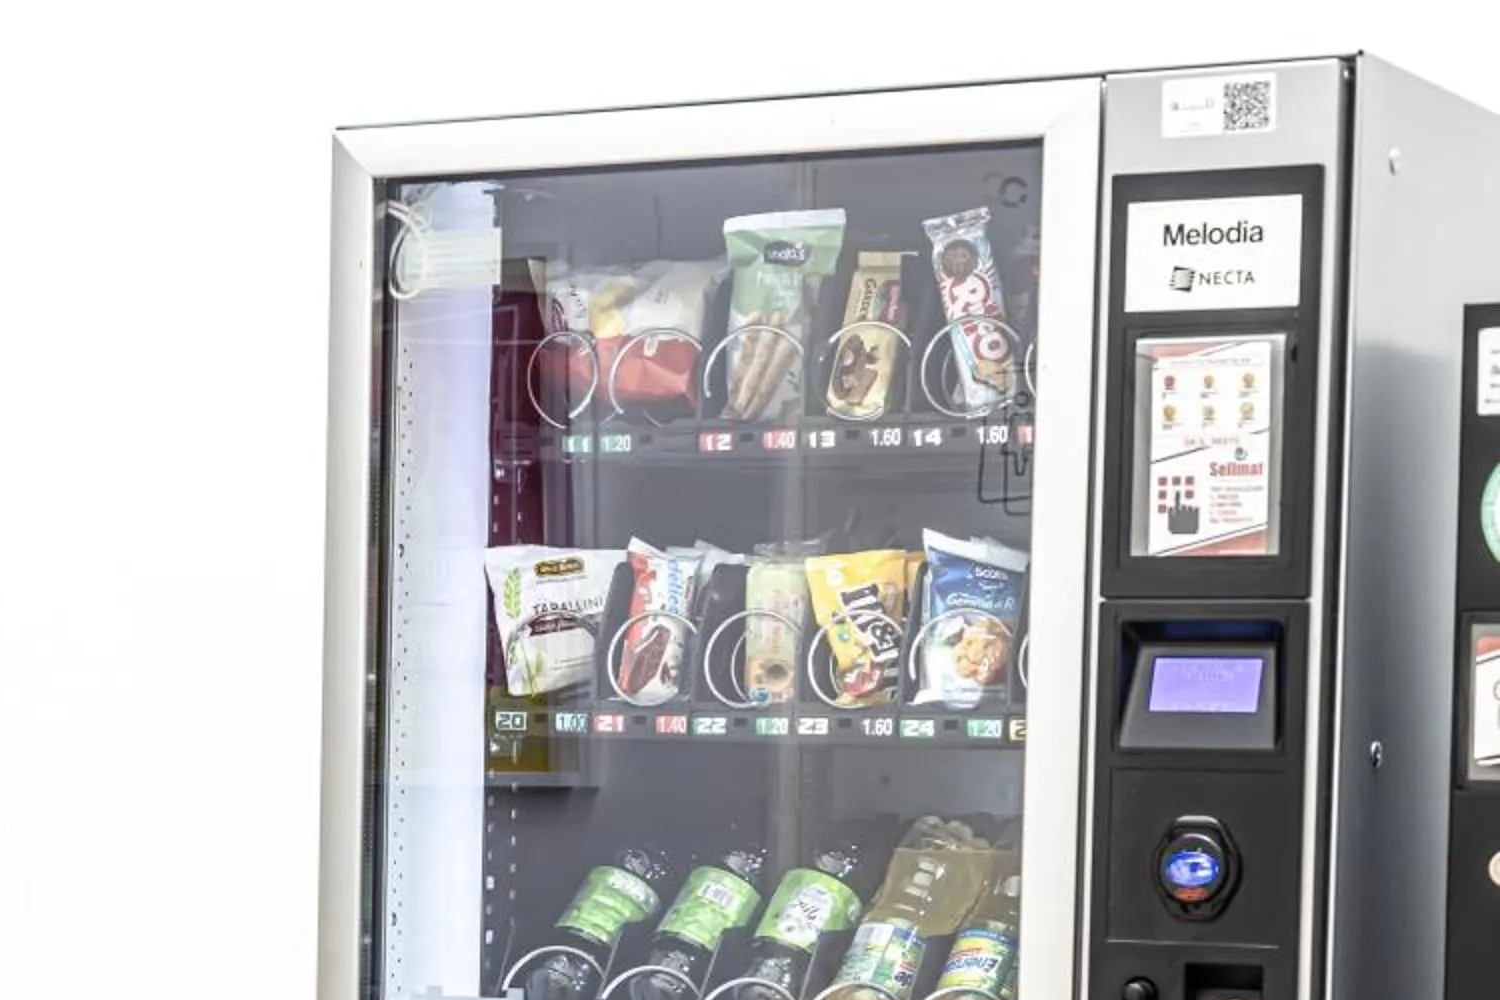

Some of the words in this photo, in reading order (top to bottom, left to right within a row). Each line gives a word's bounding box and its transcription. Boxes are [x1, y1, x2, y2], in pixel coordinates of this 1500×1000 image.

[1163, 220, 1264, 247] Melodia
[1198, 270, 1256, 285] NECTA
[705, 433, 733, 451] 12
[763, 430, 796, 449] 1.40
[808, 430, 836, 448] 13
[871, 427, 901, 446] 1.60
[913, 428, 942, 447] 14
[976, 426, 1008, 445] 1.60
[497, 712, 527, 731] 20
[597, 715, 625, 733] 21
[656, 716, 688, 734] 1.40
[694, 717, 728, 735] 22
[758, 718, 789, 736] 1.20
[798, 718, 829, 735] 23
[862, 718, 893, 736] 1.60
[902, 719, 934, 737] 24
[969, 719, 1002, 738] 1.20
